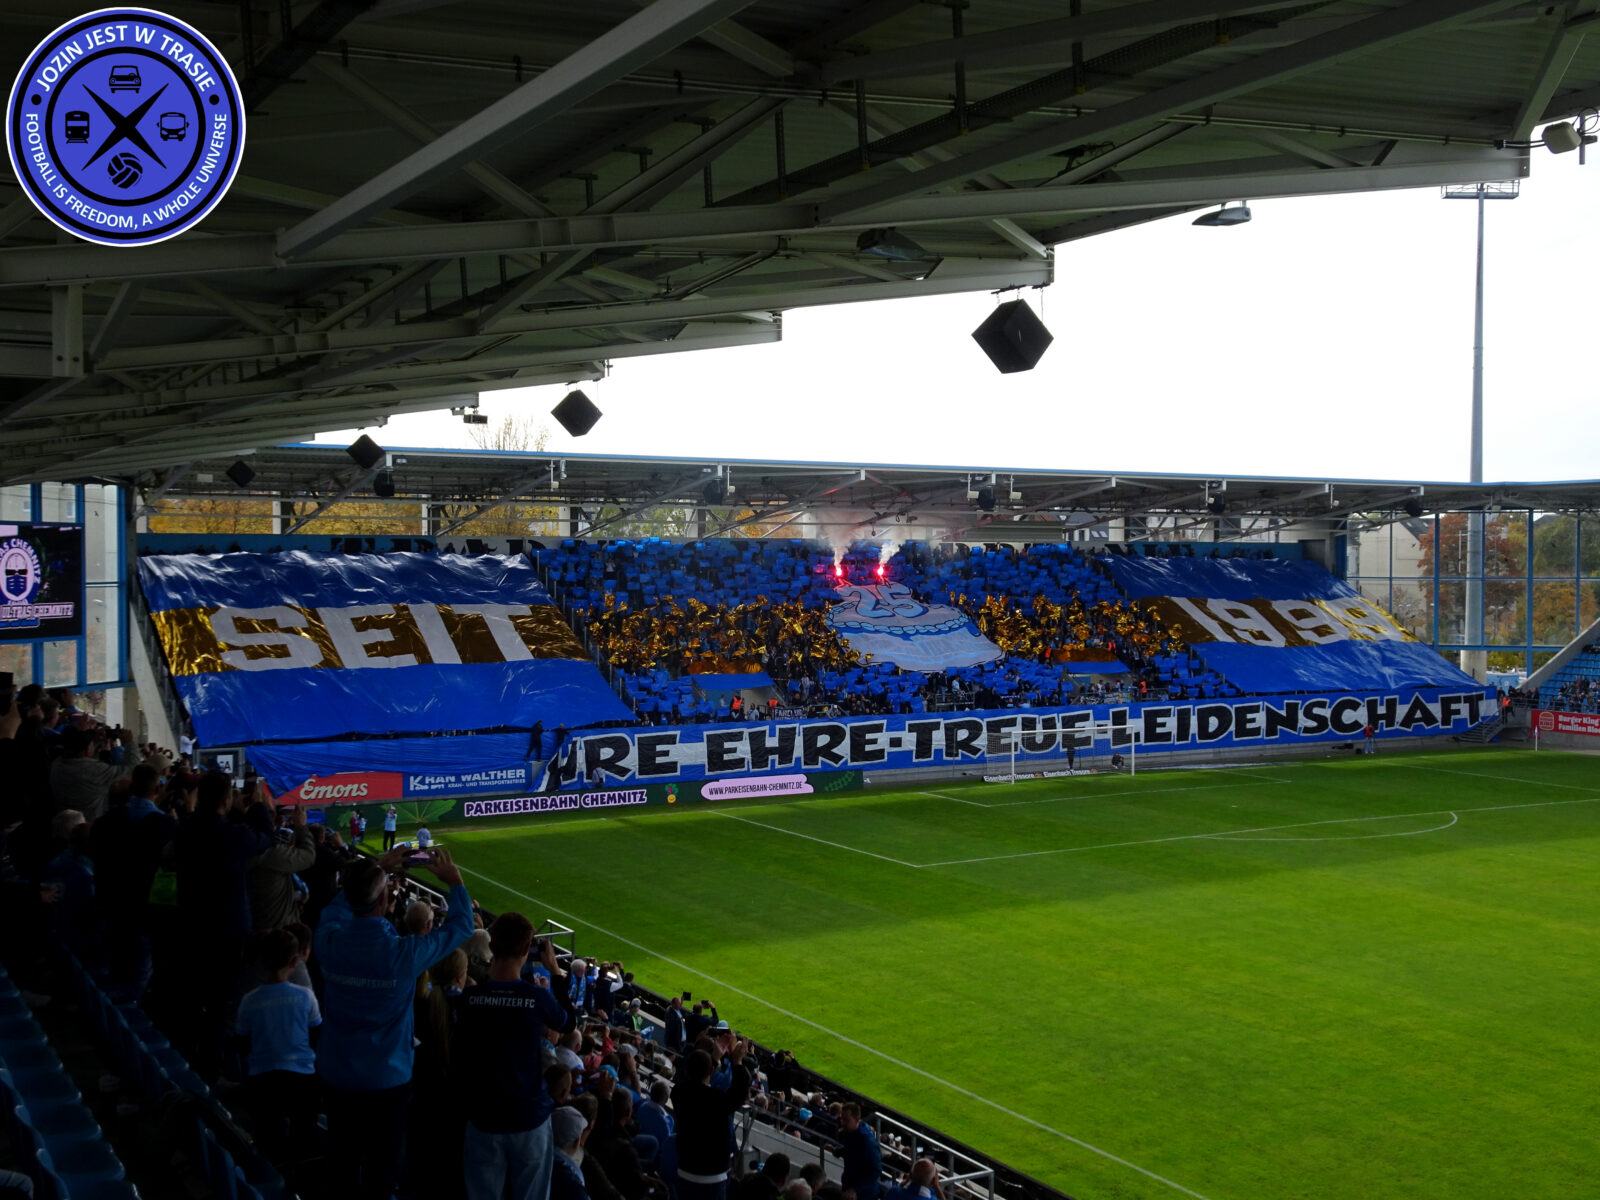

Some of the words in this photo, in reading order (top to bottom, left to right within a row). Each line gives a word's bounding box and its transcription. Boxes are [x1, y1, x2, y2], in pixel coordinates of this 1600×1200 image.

[10, 538, 41, 584] CHEMNITZ
[1168, 596, 1404, 648] 1999
[210, 602, 534, 671] SEIT
[1558, 715, 1582, 724] Burger
[460, 769, 526, 781] WALTHER
[299, 778, 368, 800] Emons
[708, 781, 803, 796] WWW.PARKEISENBAHN-CHEMNITZ.DE
[464, 794, 579, 817] PARKEISENBAHN
[581, 789, 647, 807] CHEMNITZ
[468, 995, 523, 1008] CHEMNITZER
[524, 998, 536, 1009] FC
